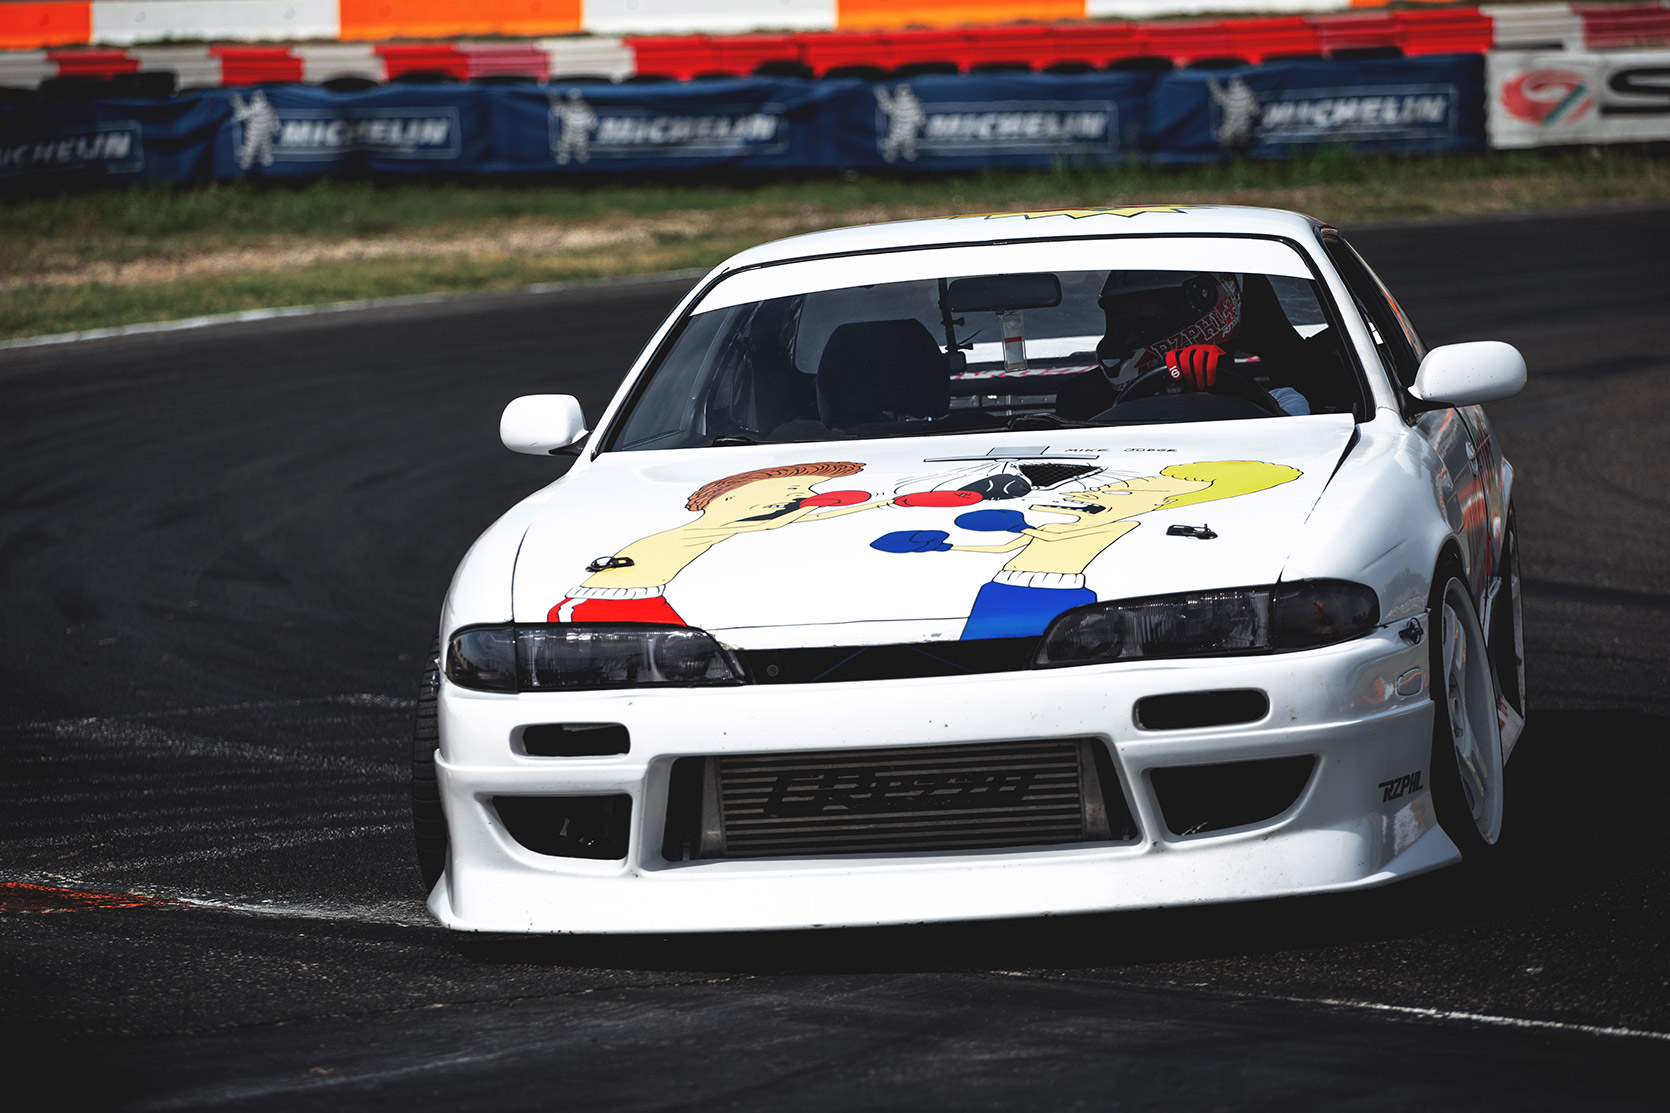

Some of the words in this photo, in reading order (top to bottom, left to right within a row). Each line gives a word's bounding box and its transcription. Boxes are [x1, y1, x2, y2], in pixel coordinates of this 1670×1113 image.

[926, 112, 1107, 140] MICHELIN
[1261, 96, 1448, 128] MICHELIN
[281, 118, 448, 147] MICHELIN
[600, 113, 778, 143] MICHELIN
[0, 131, 132, 167] ICHELIN
[1378, 770, 1424, 803] RZPHL
